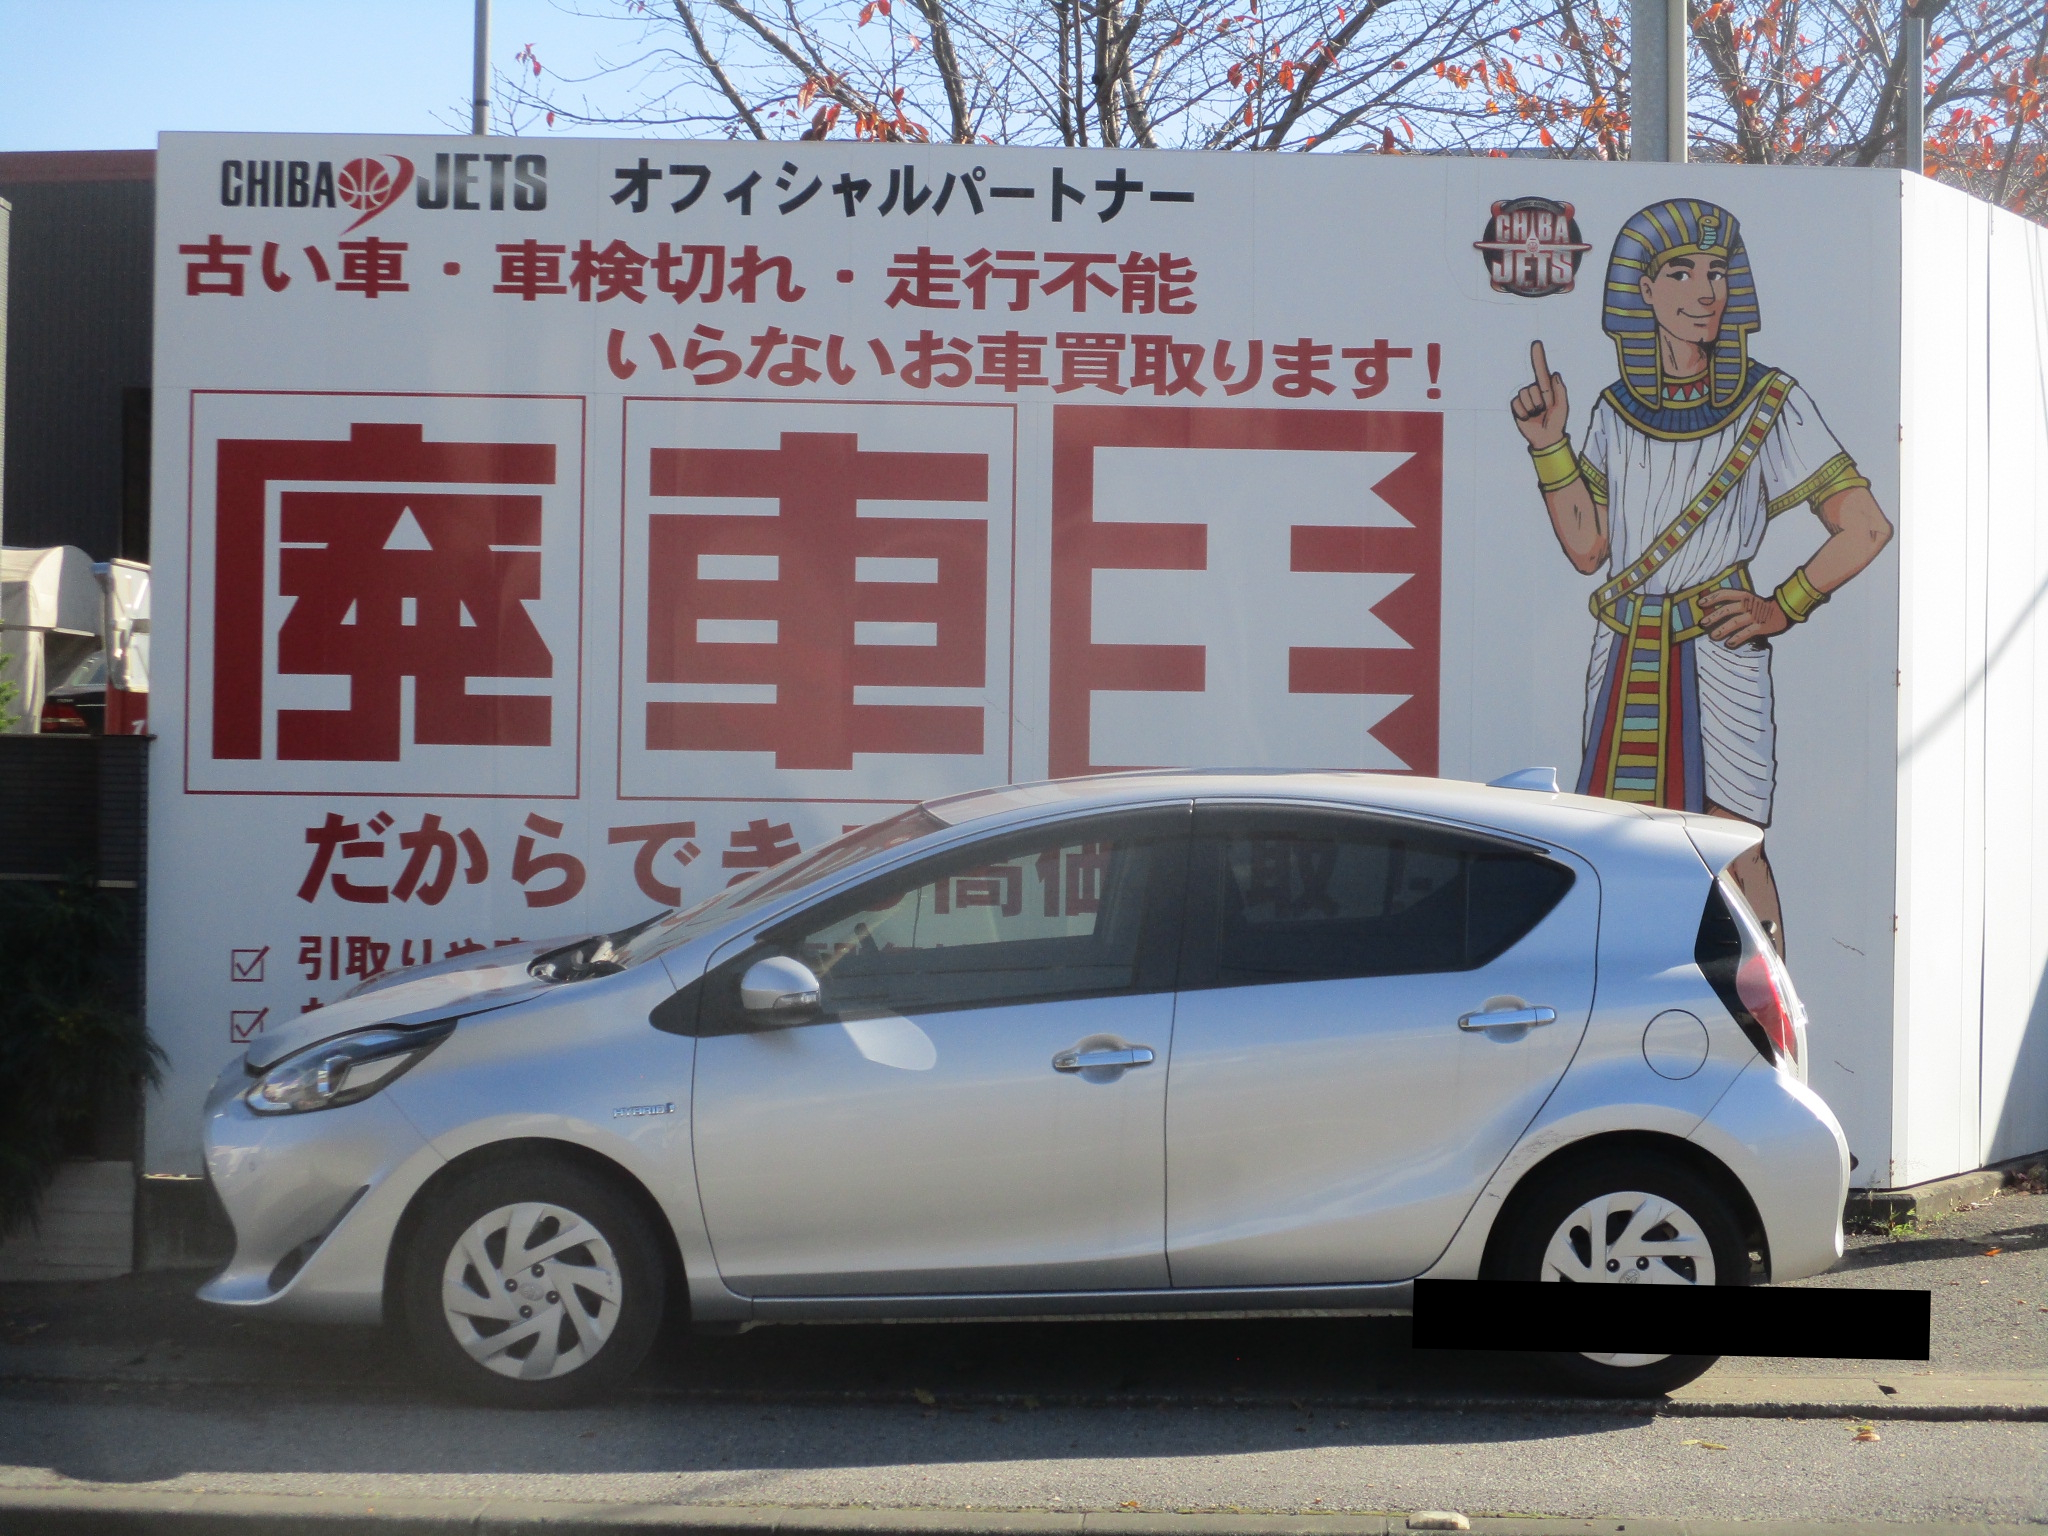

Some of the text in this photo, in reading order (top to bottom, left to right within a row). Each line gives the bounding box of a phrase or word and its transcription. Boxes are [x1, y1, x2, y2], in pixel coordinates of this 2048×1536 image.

[221, 153, 547, 212] CHIBA JETS
[611, 157, 1196, 223] オフィシャルパートナー
[1496, 212, 1570, 243] CHIBA
[178, 233, 1198, 316] 古い車・車検切れ・走行不能
[1491, 250, 1573, 287] JETS
[606, 323, 1443, 401] いらないお車買取ります！
